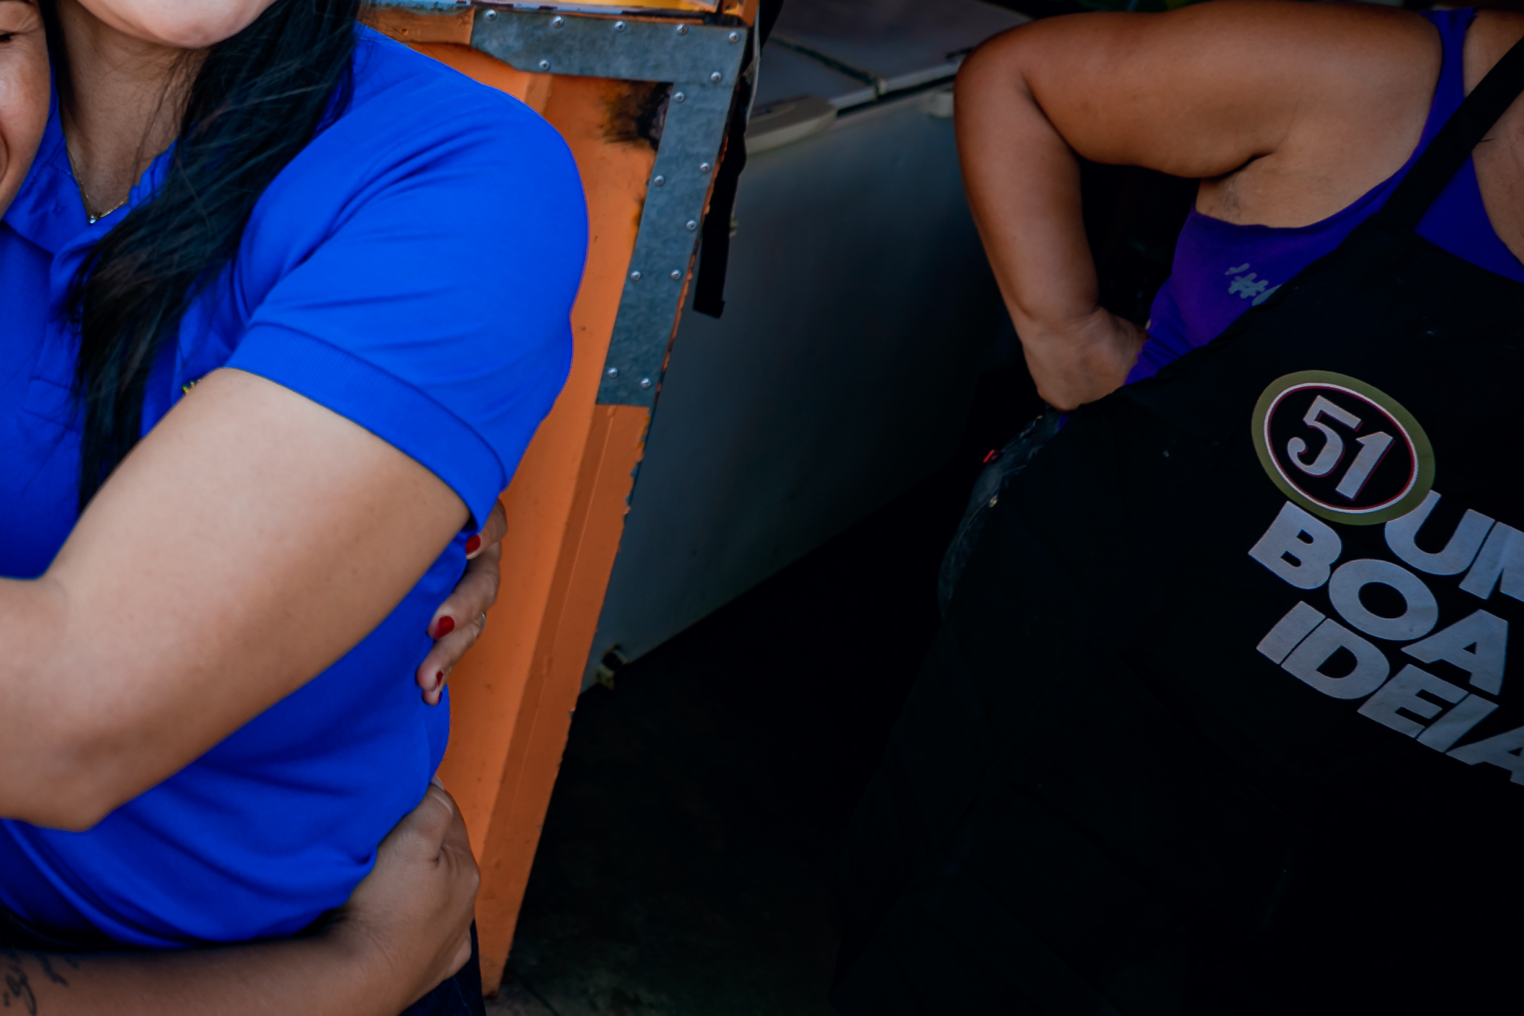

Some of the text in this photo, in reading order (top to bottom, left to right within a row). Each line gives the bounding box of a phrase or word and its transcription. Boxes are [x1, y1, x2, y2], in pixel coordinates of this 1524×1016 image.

[1287, 395, 1394, 500] 51
[1249, 502, 1508, 696] BOA
[1256, 601, 1524, 786] IDEIA
